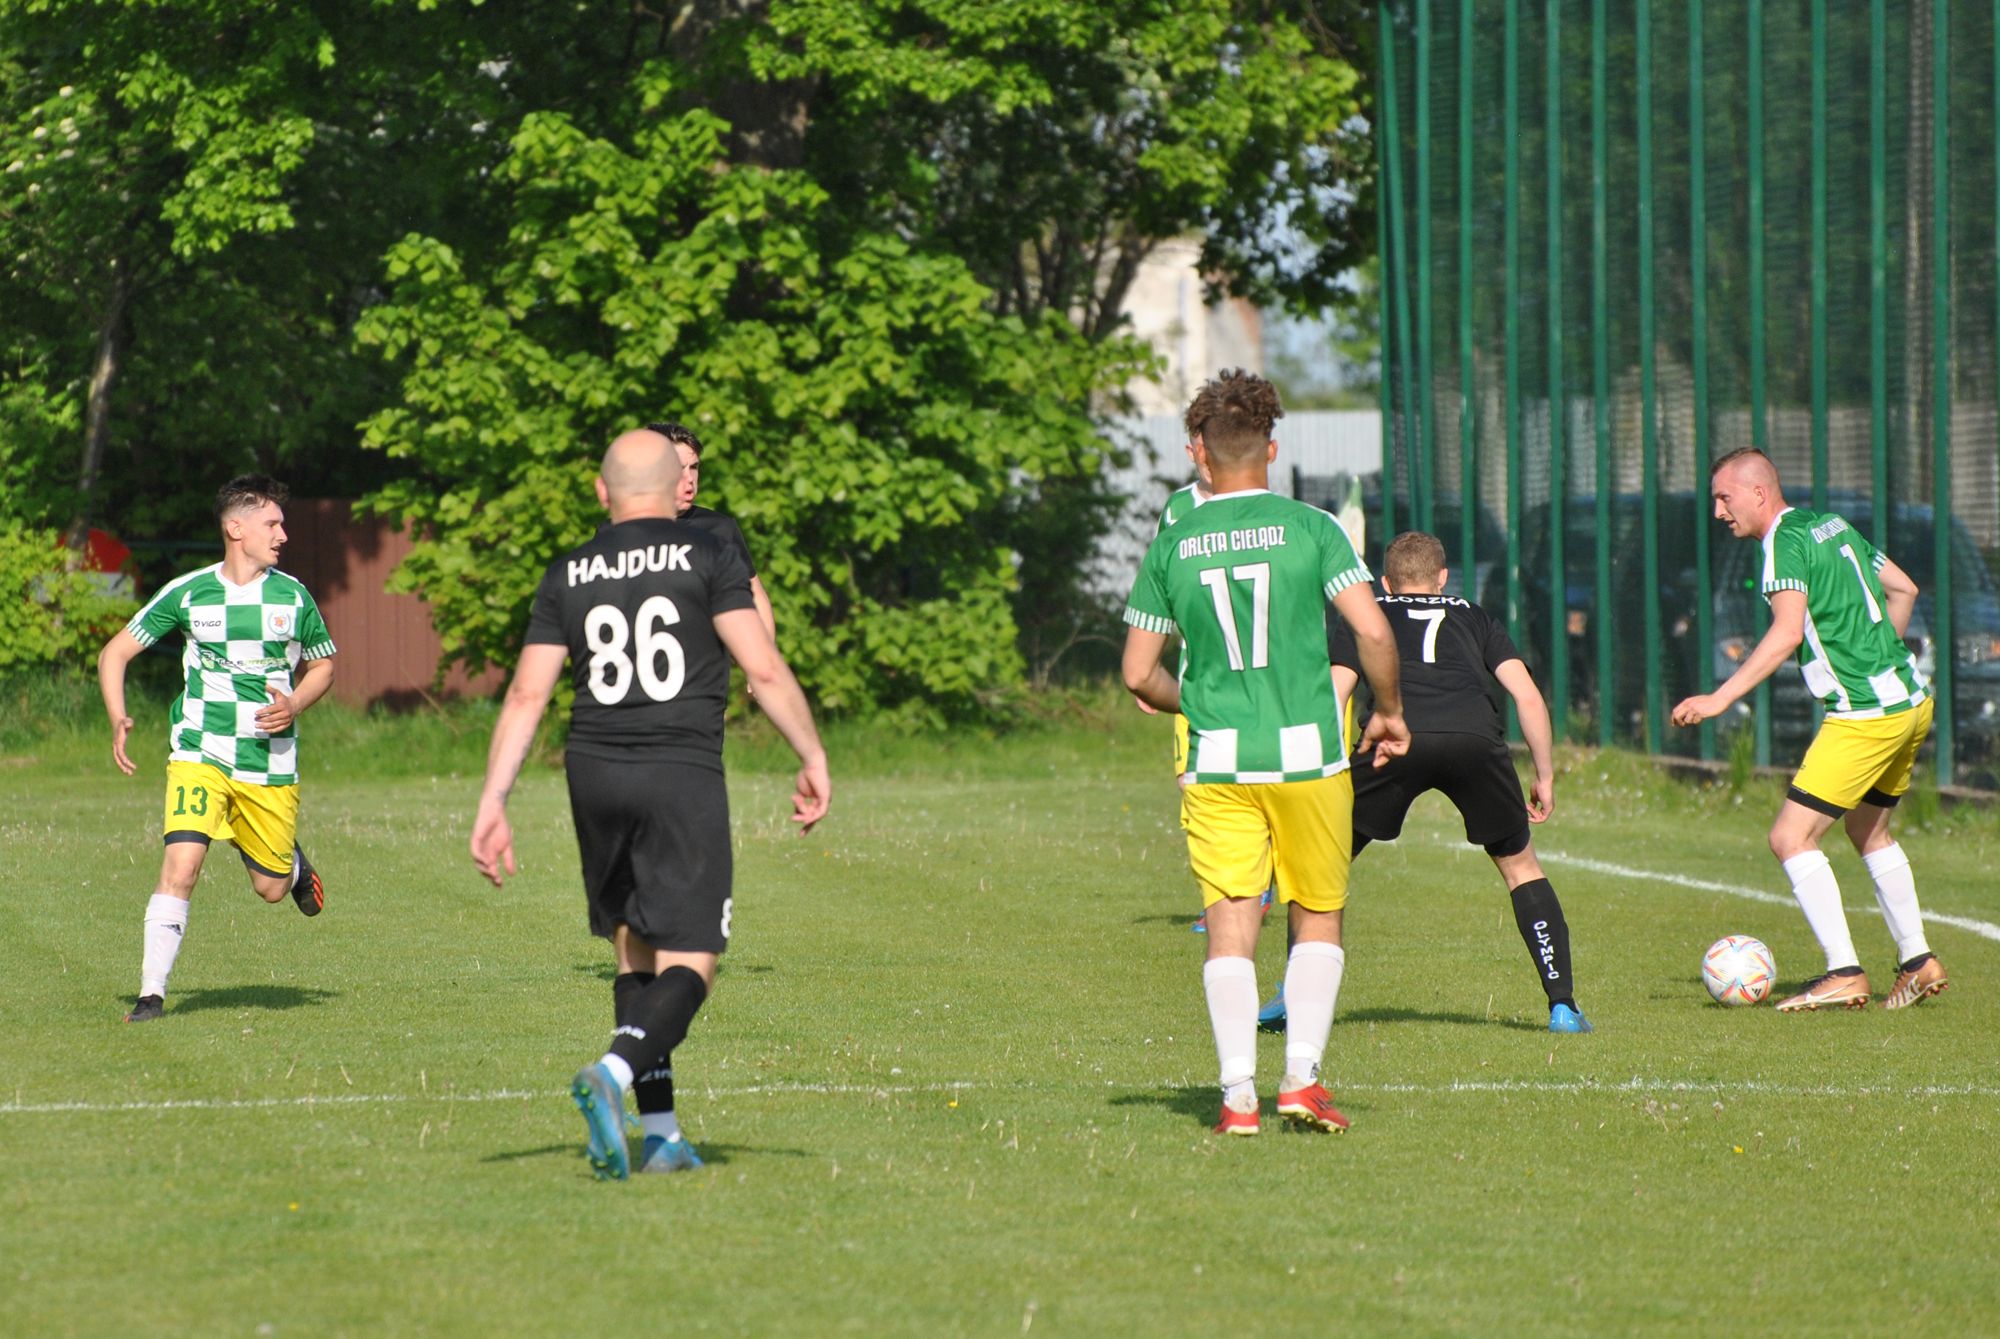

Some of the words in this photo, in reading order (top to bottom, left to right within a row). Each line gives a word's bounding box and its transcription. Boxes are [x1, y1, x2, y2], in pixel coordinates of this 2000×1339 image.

[567, 543, 693, 587] HAJDUK
[1179, 532, 1228, 560] ORLĘTA
[1230, 525, 1286, 551] CIELĄDZ
[1839, 544, 1883, 624] 1
[1200, 560, 1271, 673] 17
[1406, 608, 1446, 663] 7
[584, 595, 686, 706] 86
[173, 785, 208, 816] 13
[1533, 920, 1560, 980] OLYMPIC
